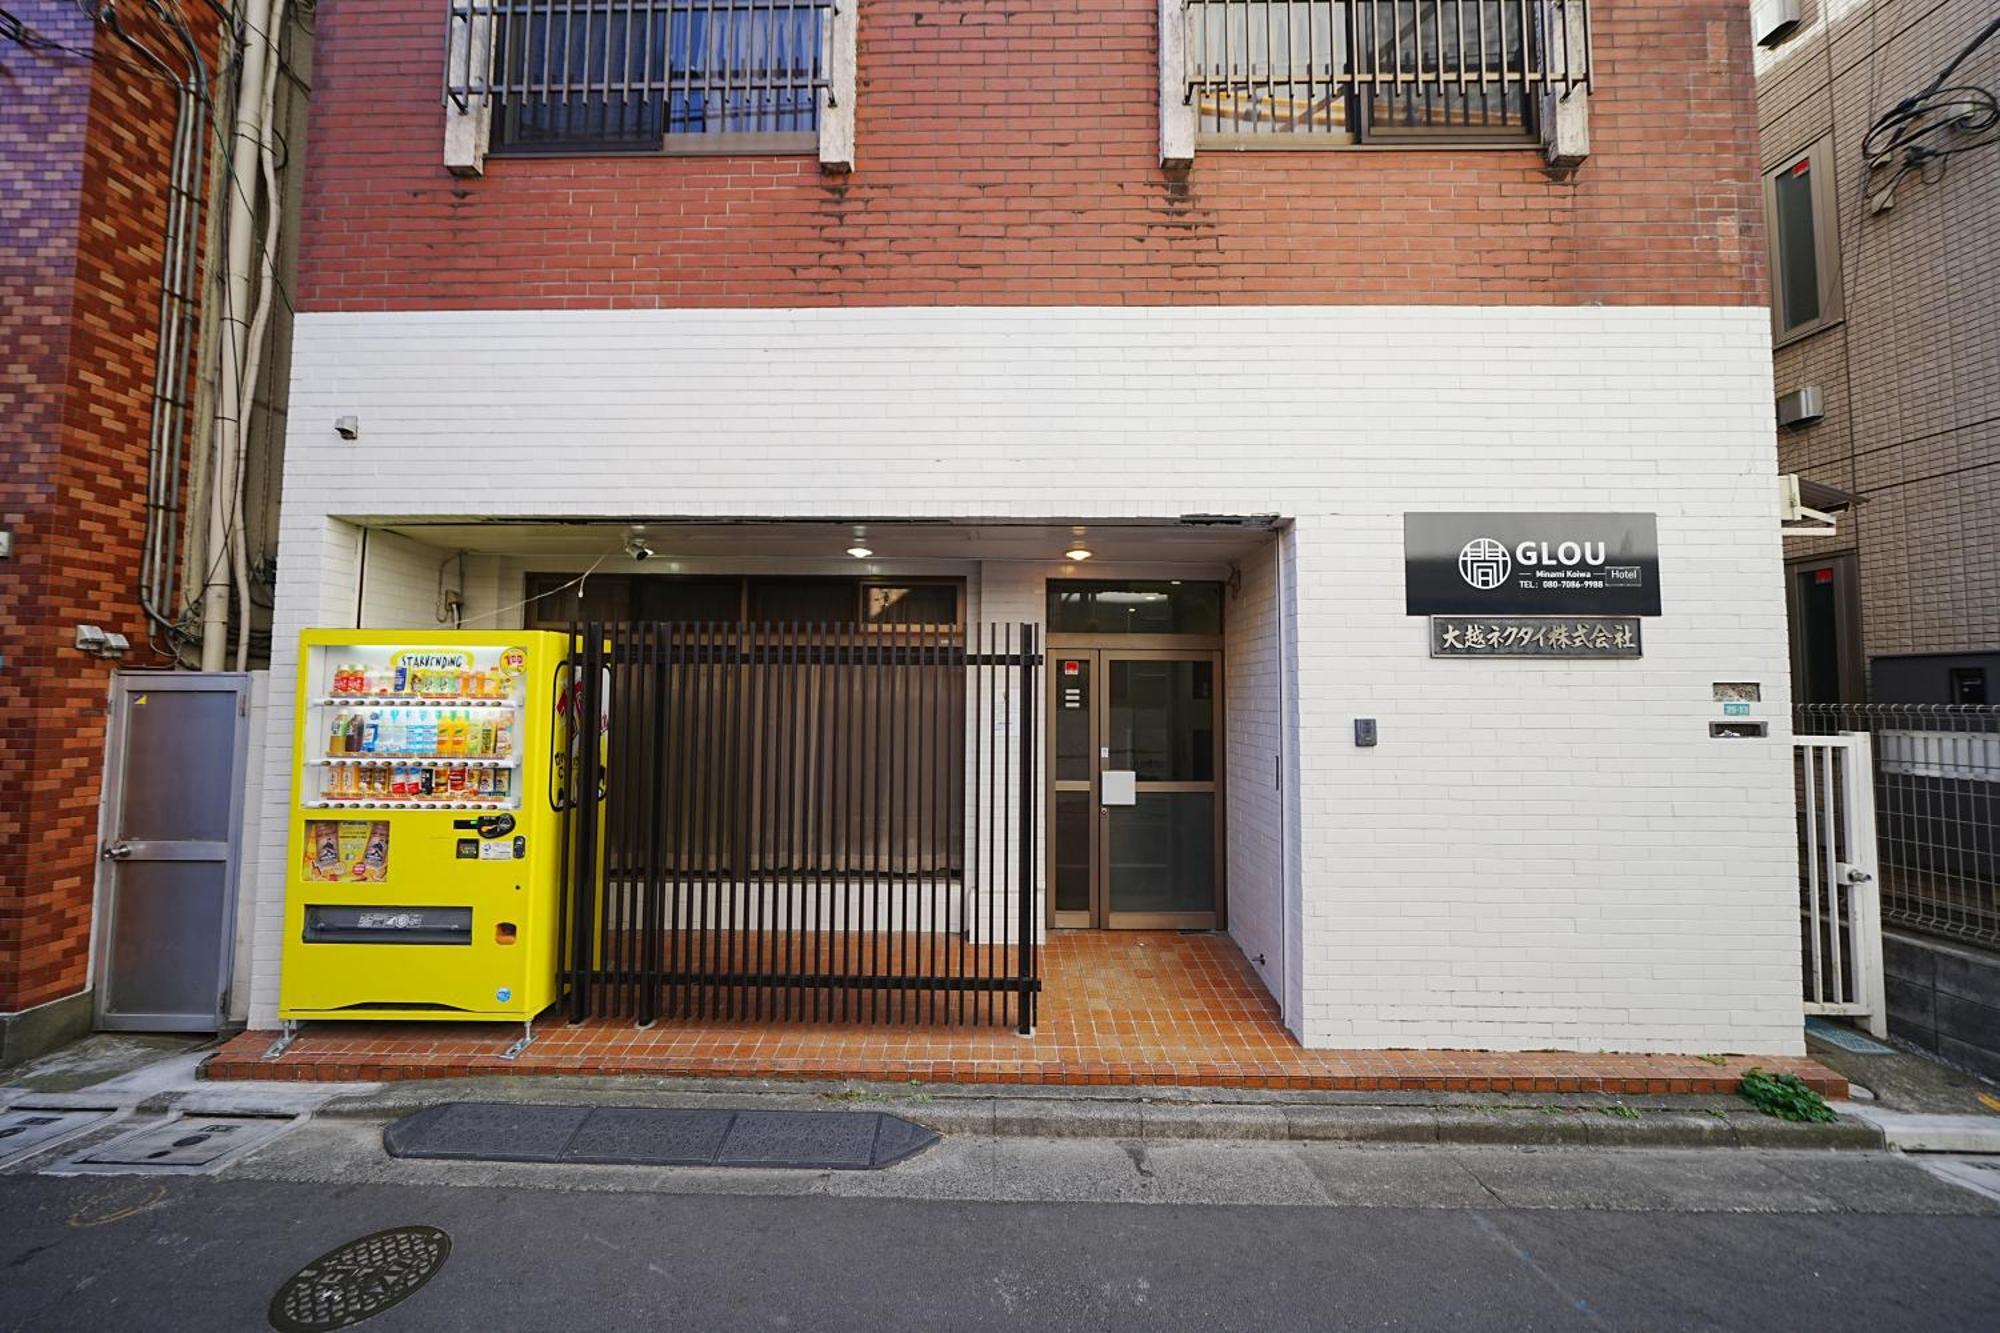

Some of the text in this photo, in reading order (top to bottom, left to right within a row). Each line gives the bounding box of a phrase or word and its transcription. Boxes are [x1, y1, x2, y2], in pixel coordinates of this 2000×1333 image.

[1515, 541, 1606, 566] GLOU
[1535, 569, 1592, 578] Minami Koiwa
[1611, 569, 1637, 579] Hotel
[1442, 623, 1636, 649] 大越ネクタイ株式会社
